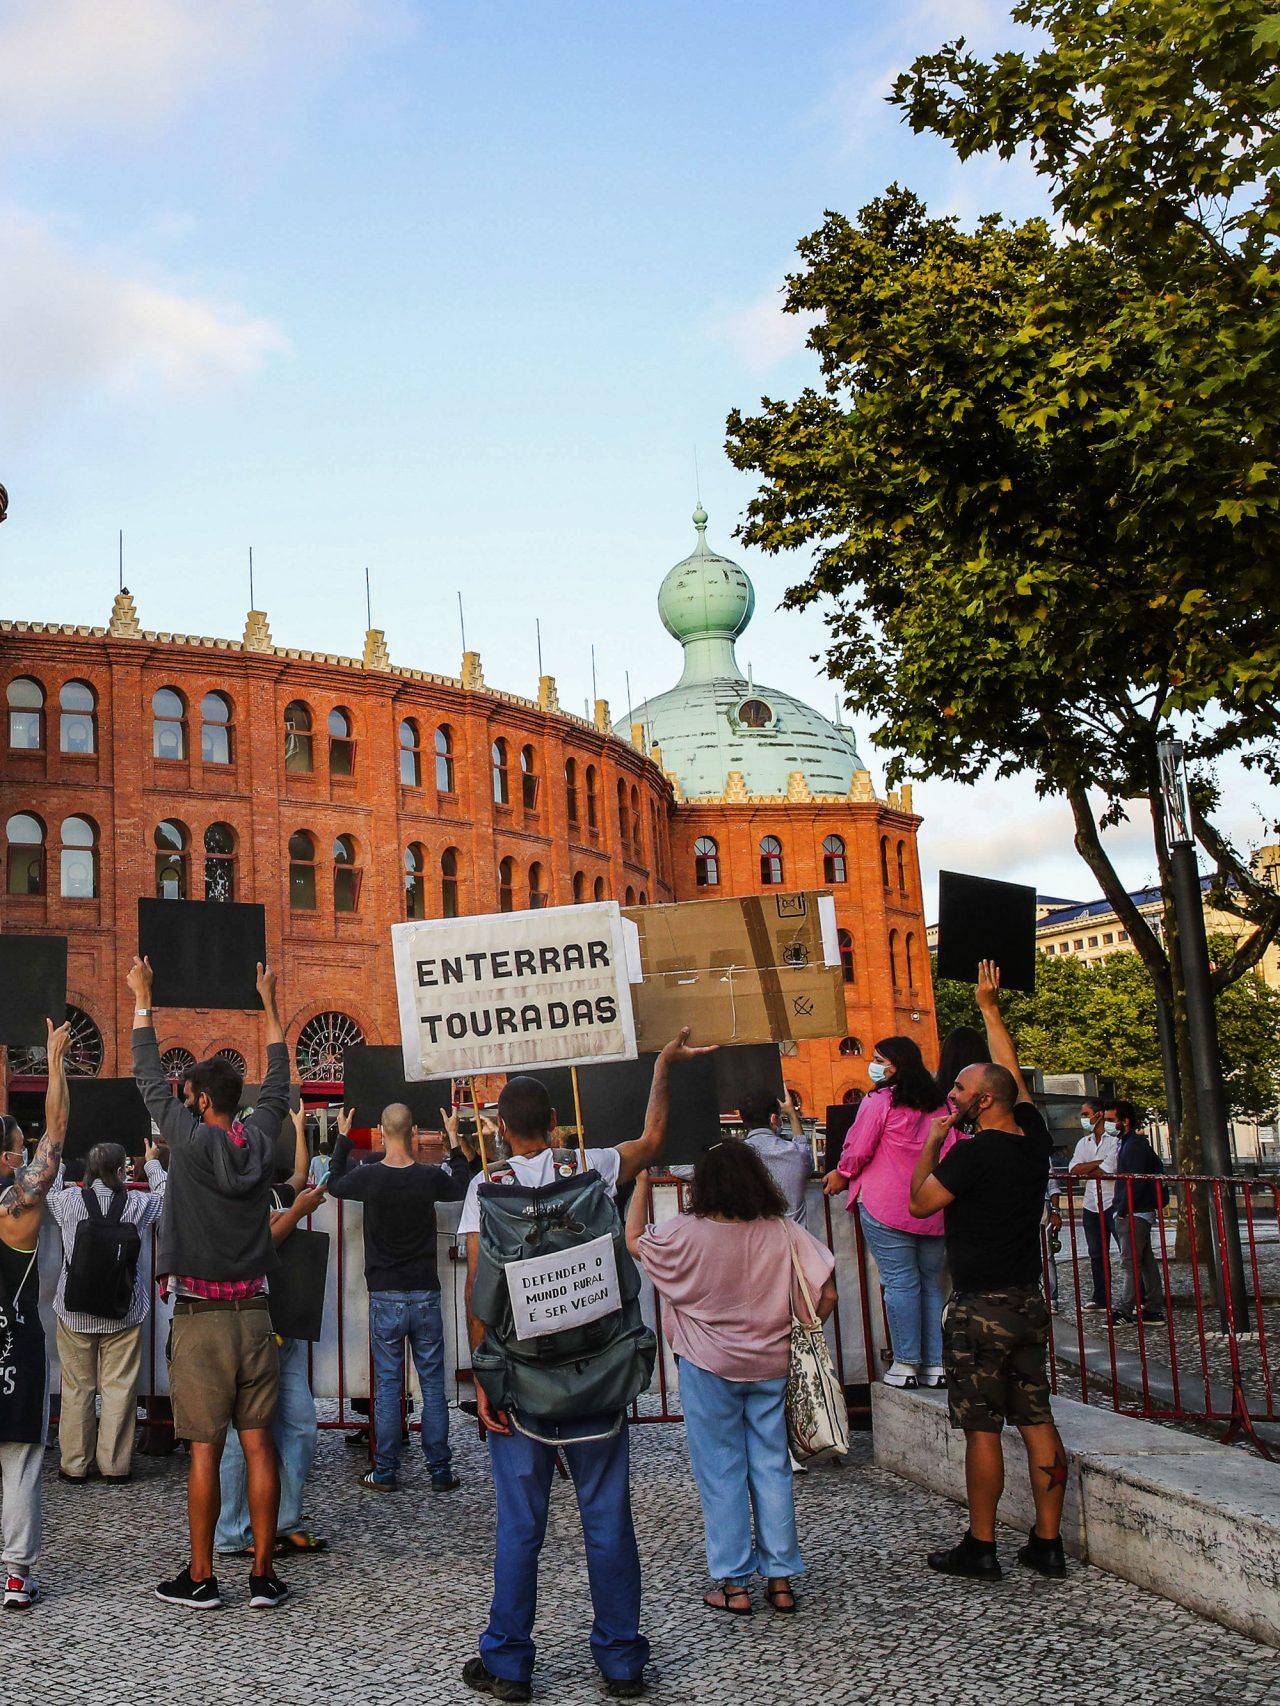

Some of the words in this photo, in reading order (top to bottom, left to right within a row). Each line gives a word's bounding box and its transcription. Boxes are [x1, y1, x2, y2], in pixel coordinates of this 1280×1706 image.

[416, 939, 611, 988] ENTERRAR
[420, 995, 618, 1044] TOURADAS
[522, 1262, 587, 1289] DEFENDER
[595, 1257, 602, 1267] O
[525, 1285, 568, 1305] MUNDO
[573, 1272, 605, 1292] RURAL
[529, 1308, 538, 1322] É
[545, 1304, 568, 1318] SER
[570, 1287, 609, 1311] VEGAN
